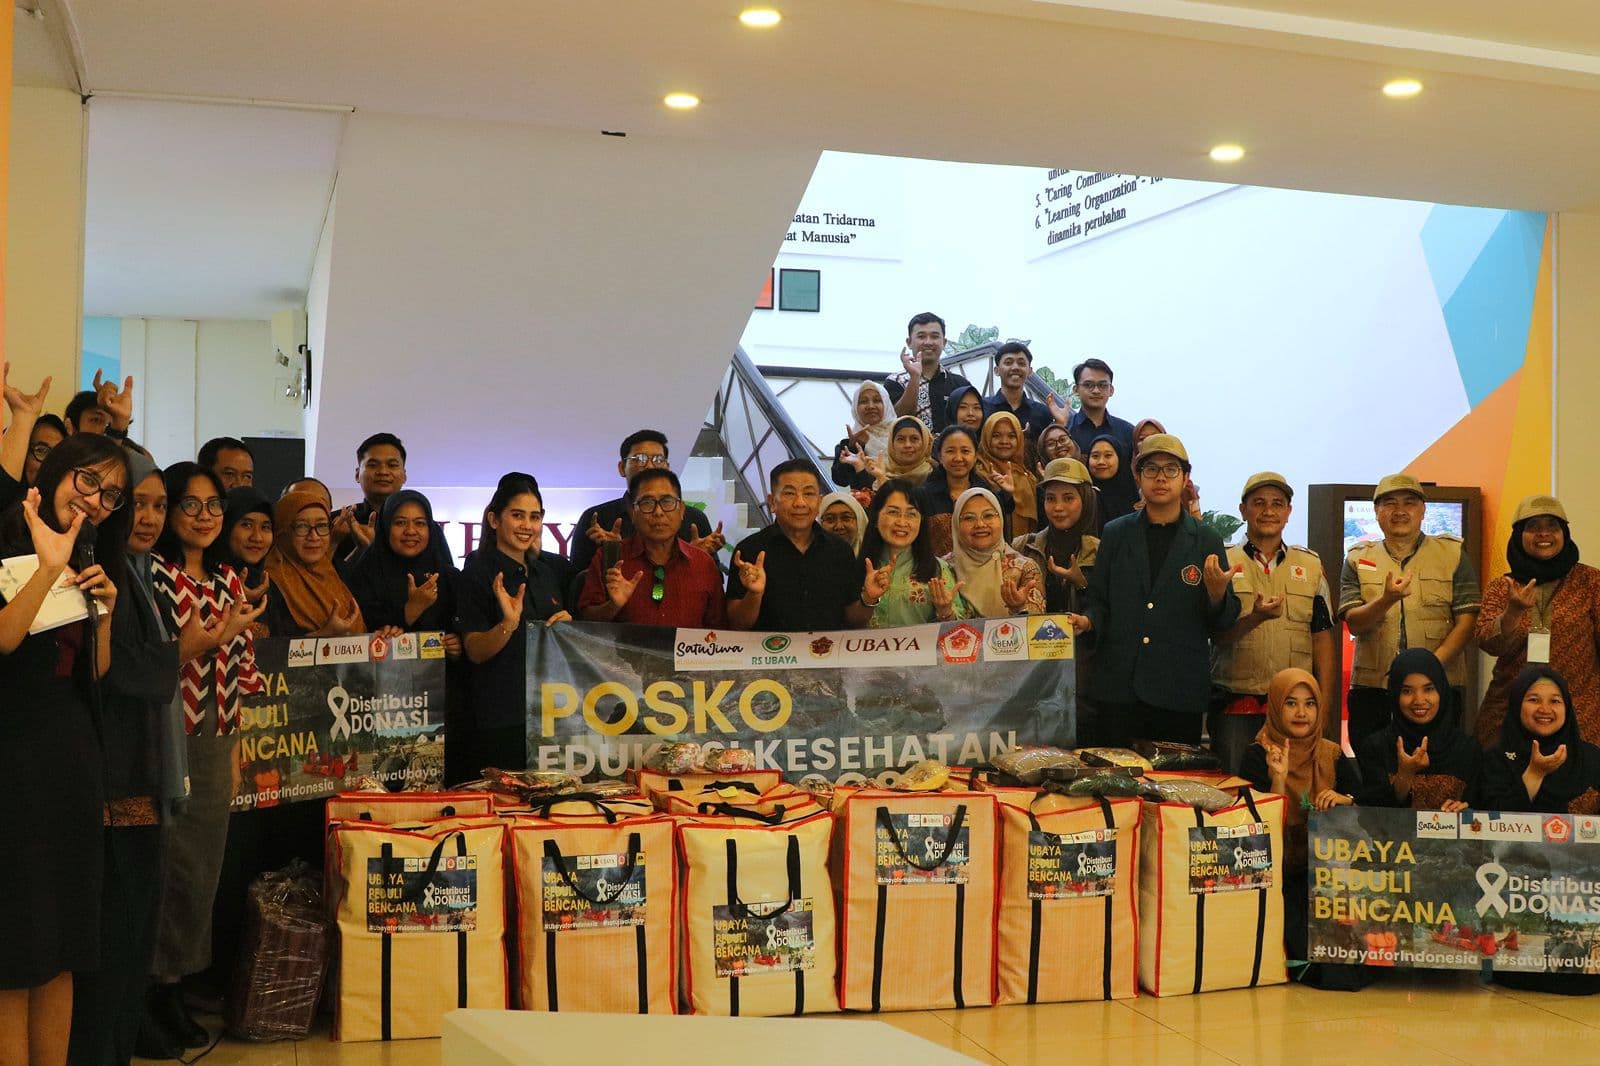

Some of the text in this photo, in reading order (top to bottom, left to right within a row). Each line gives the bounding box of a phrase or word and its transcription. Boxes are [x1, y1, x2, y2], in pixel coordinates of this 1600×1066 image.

[823, 213, 876, 227] Tridarma
[1047, 207, 1127, 245] dinamika perubahan
[784, 231, 797, 241] at
[334, 645, 363, 655] UBAYA
[845, 636, 921, 652] UBAYA
[751, 656, 764, 665] RS
[765, 655, 798, 665] UBAYA
[350, 691, 428, 713] Distribusi
[540, 678, 793, 737] POSKO
[240, 703, 288, 730] DULI
[350, 710, 428, 734] DONASI
[241, 731, 319, 762] NCANA
[754, 730, 1017, 771] KESEHATAN
[230, 779, 334, 807] bayaforIndonesia
[1489, 821, 1533, 834] UBAYA
[1030, 845, 1061, 855] UBAYA
[1314, 838, 1417, 864] UBAYA
[368, 873, 404, 885] UBYA
[544, 872, 578, 883] UBAA
[1030, 870, 1072, 881] BENCANA
[1314, 867, 1411, 893] PEDULI
[435, 886, 470, 895] Distribusi
[1509, 875, 1600, 894] Distribus
[435, 895, 470, 905] DONASI
[544, 899, 591, 911] BENCANA
[1509, 894, 1600, 914] DONAS
[1314, 896, 1457, 925] BENCANA
[715, 920, 748, 930] UBAYA
[716, 945, 761, 957] BENCANA
[1313, 945, 1478, 965] #UbayaforIndonesia
[1496, 954, 1600, 971] #satujiwaUba
